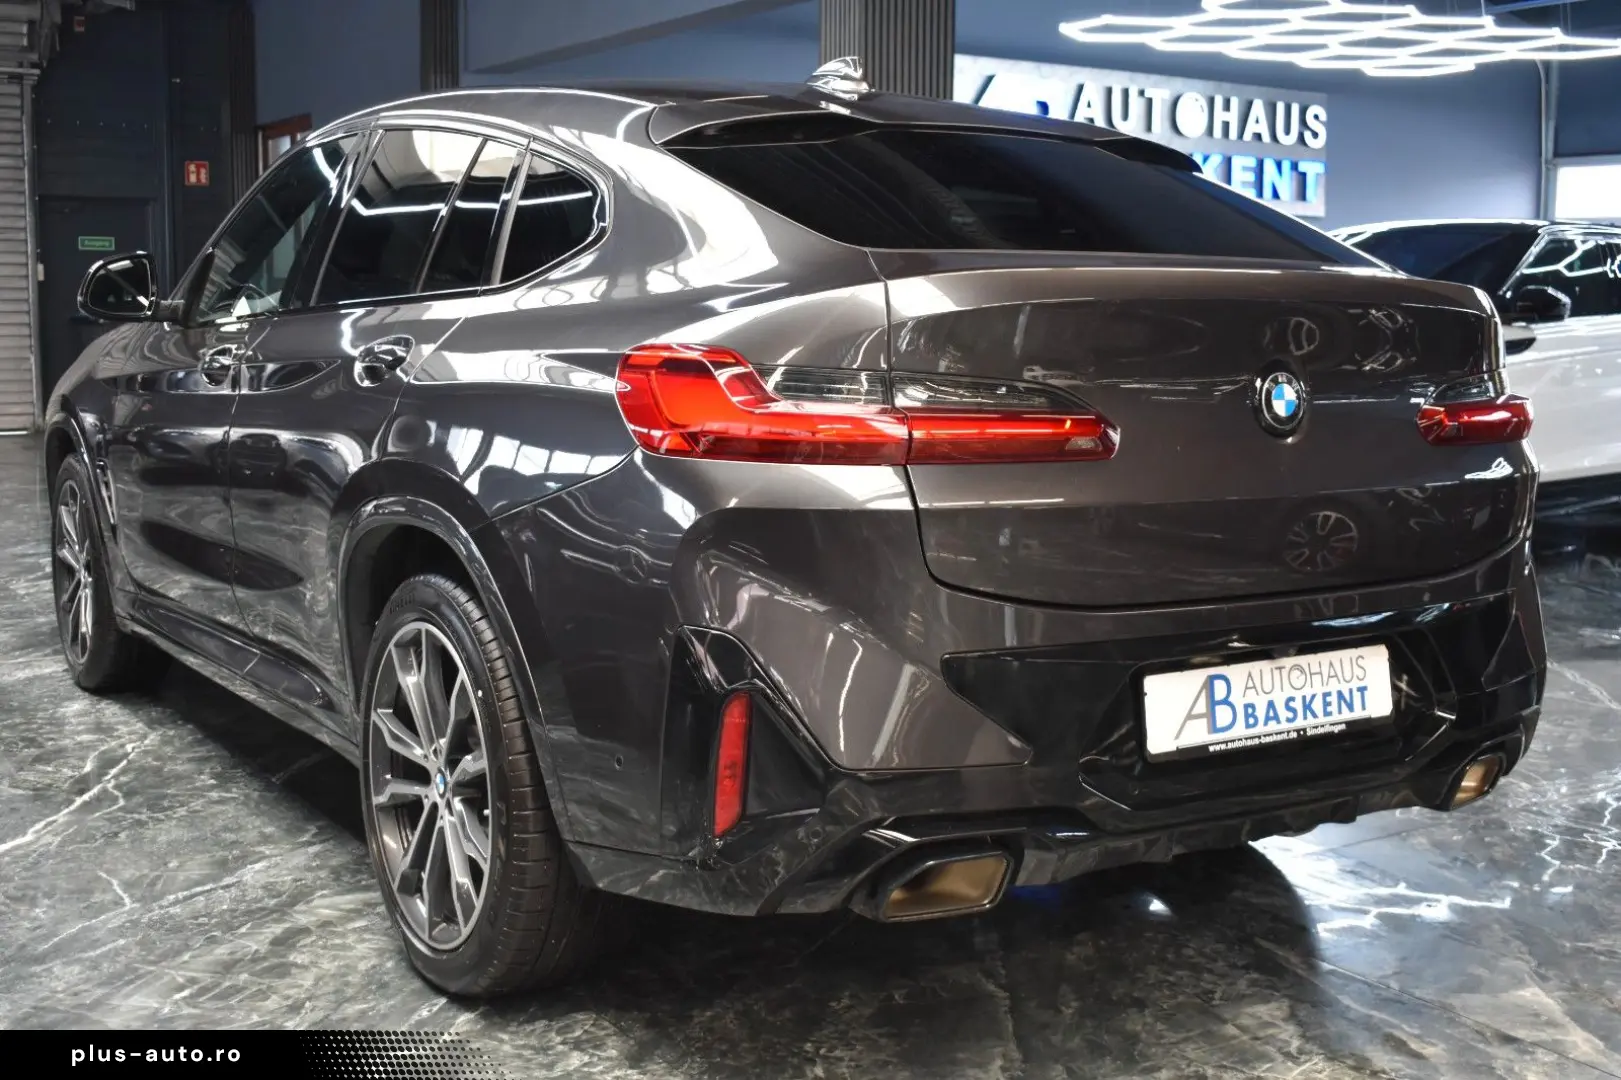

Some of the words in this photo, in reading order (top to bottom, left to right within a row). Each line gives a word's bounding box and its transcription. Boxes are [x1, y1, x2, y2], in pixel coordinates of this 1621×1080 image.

[1072, 80, 1328, 149] AUTOHAUS
[1191, 152, 1326, 204] KENT
[1242, 655, 1367, 698] AUTOHAUS
[1174, 673, 1238, 740] AB
[1243, 685, 1369, 729] BASKENT
[1208, 730, 1298, 753] www.autohaus-baskent.de
